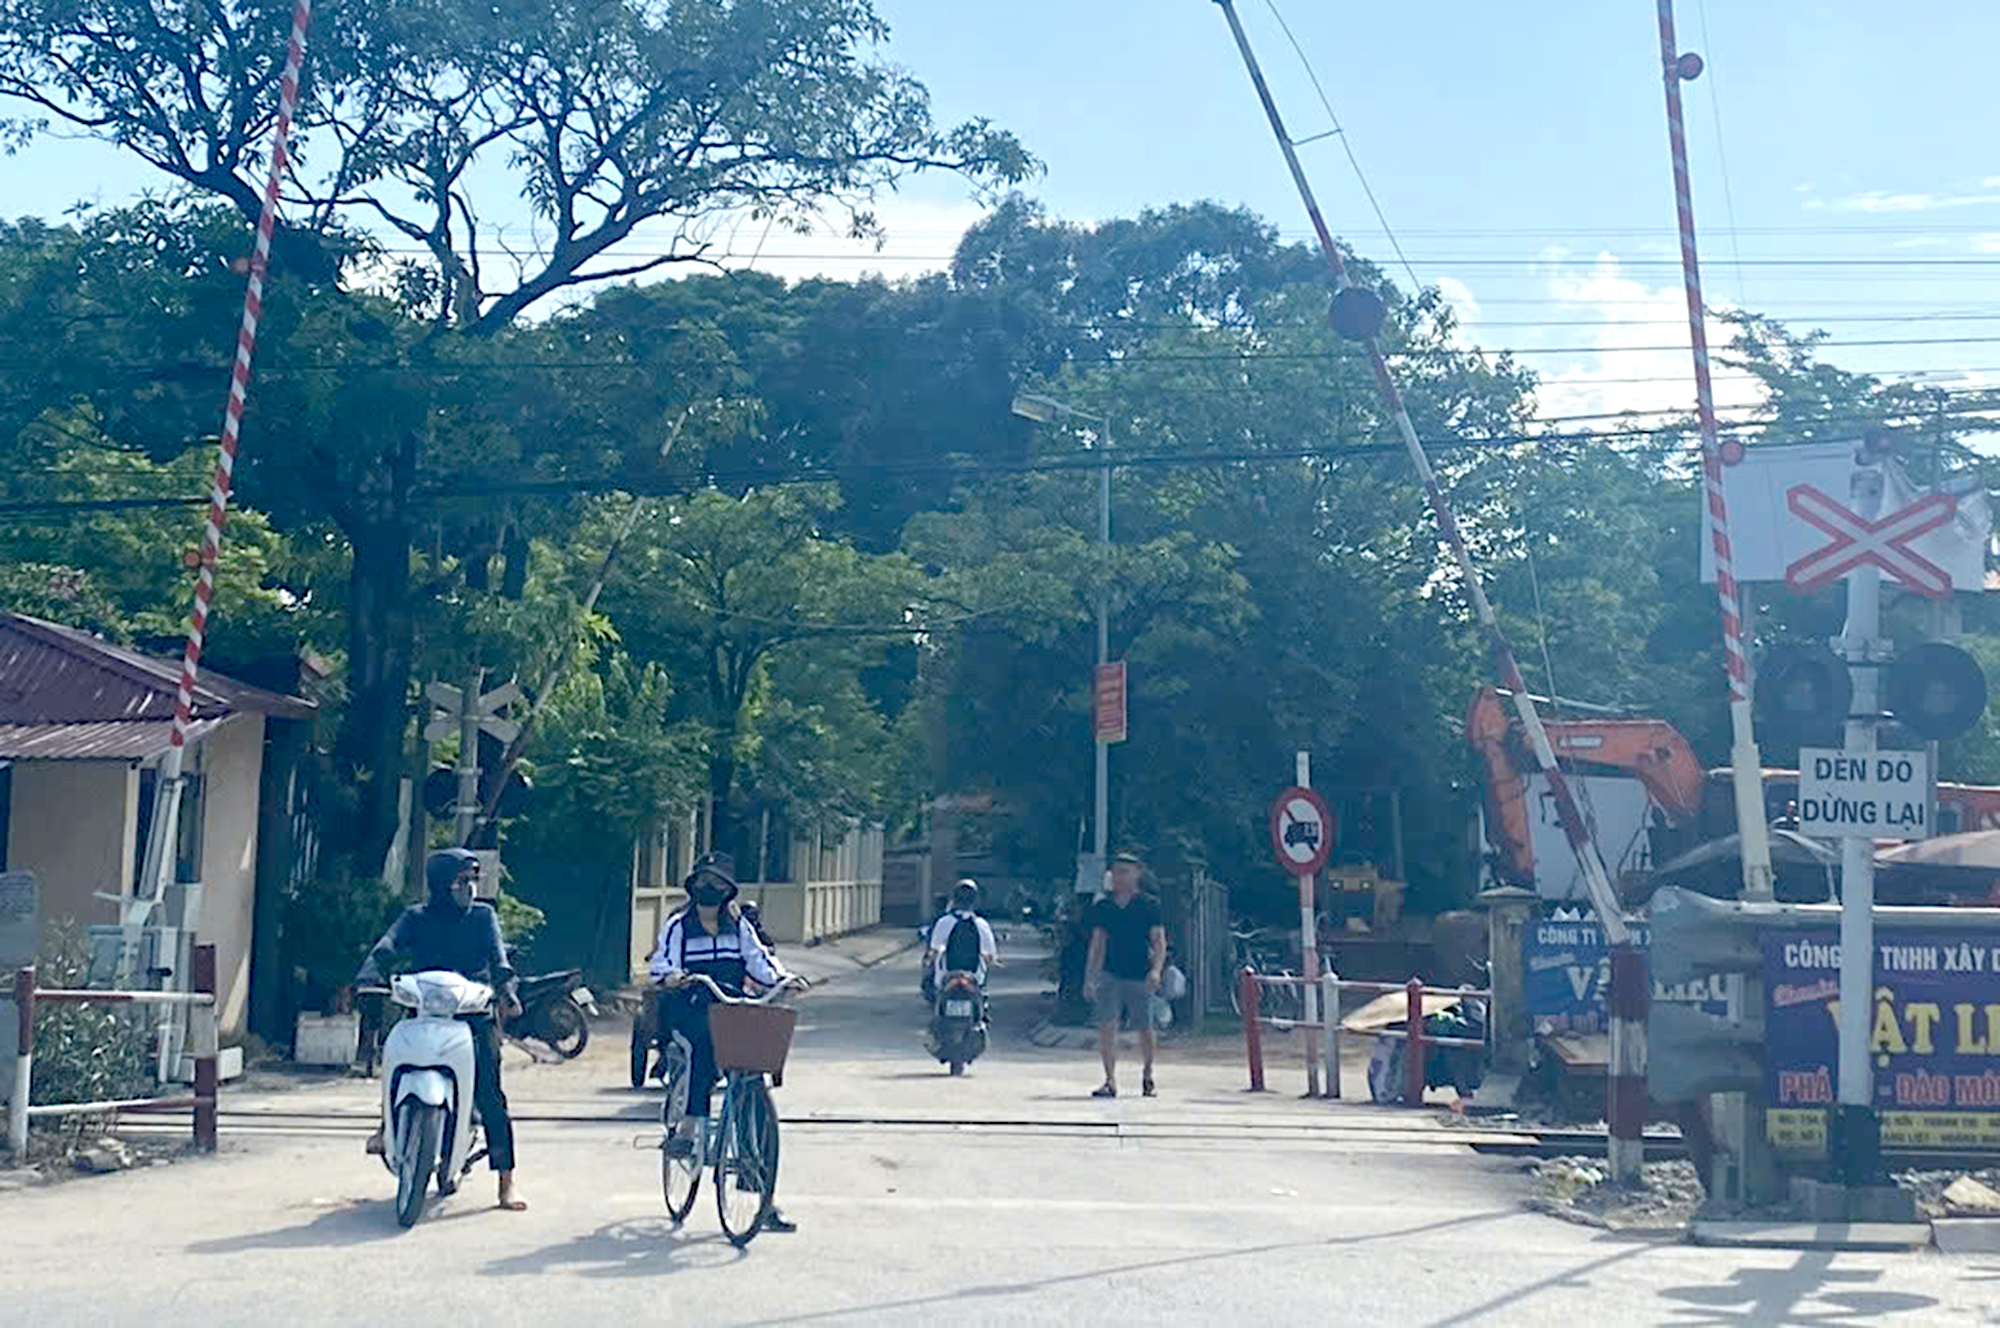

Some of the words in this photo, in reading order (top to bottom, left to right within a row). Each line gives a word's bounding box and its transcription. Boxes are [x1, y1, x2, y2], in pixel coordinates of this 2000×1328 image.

[1803, 791, 1876, 824] DỪNG
[1886, 803, 1923, 832] LẠI
[1785, 939, 1842, 969] CÔNG
[1880, 946, 1937, 970] TNHH
[1943, 942, 1985, 970] XÂY
